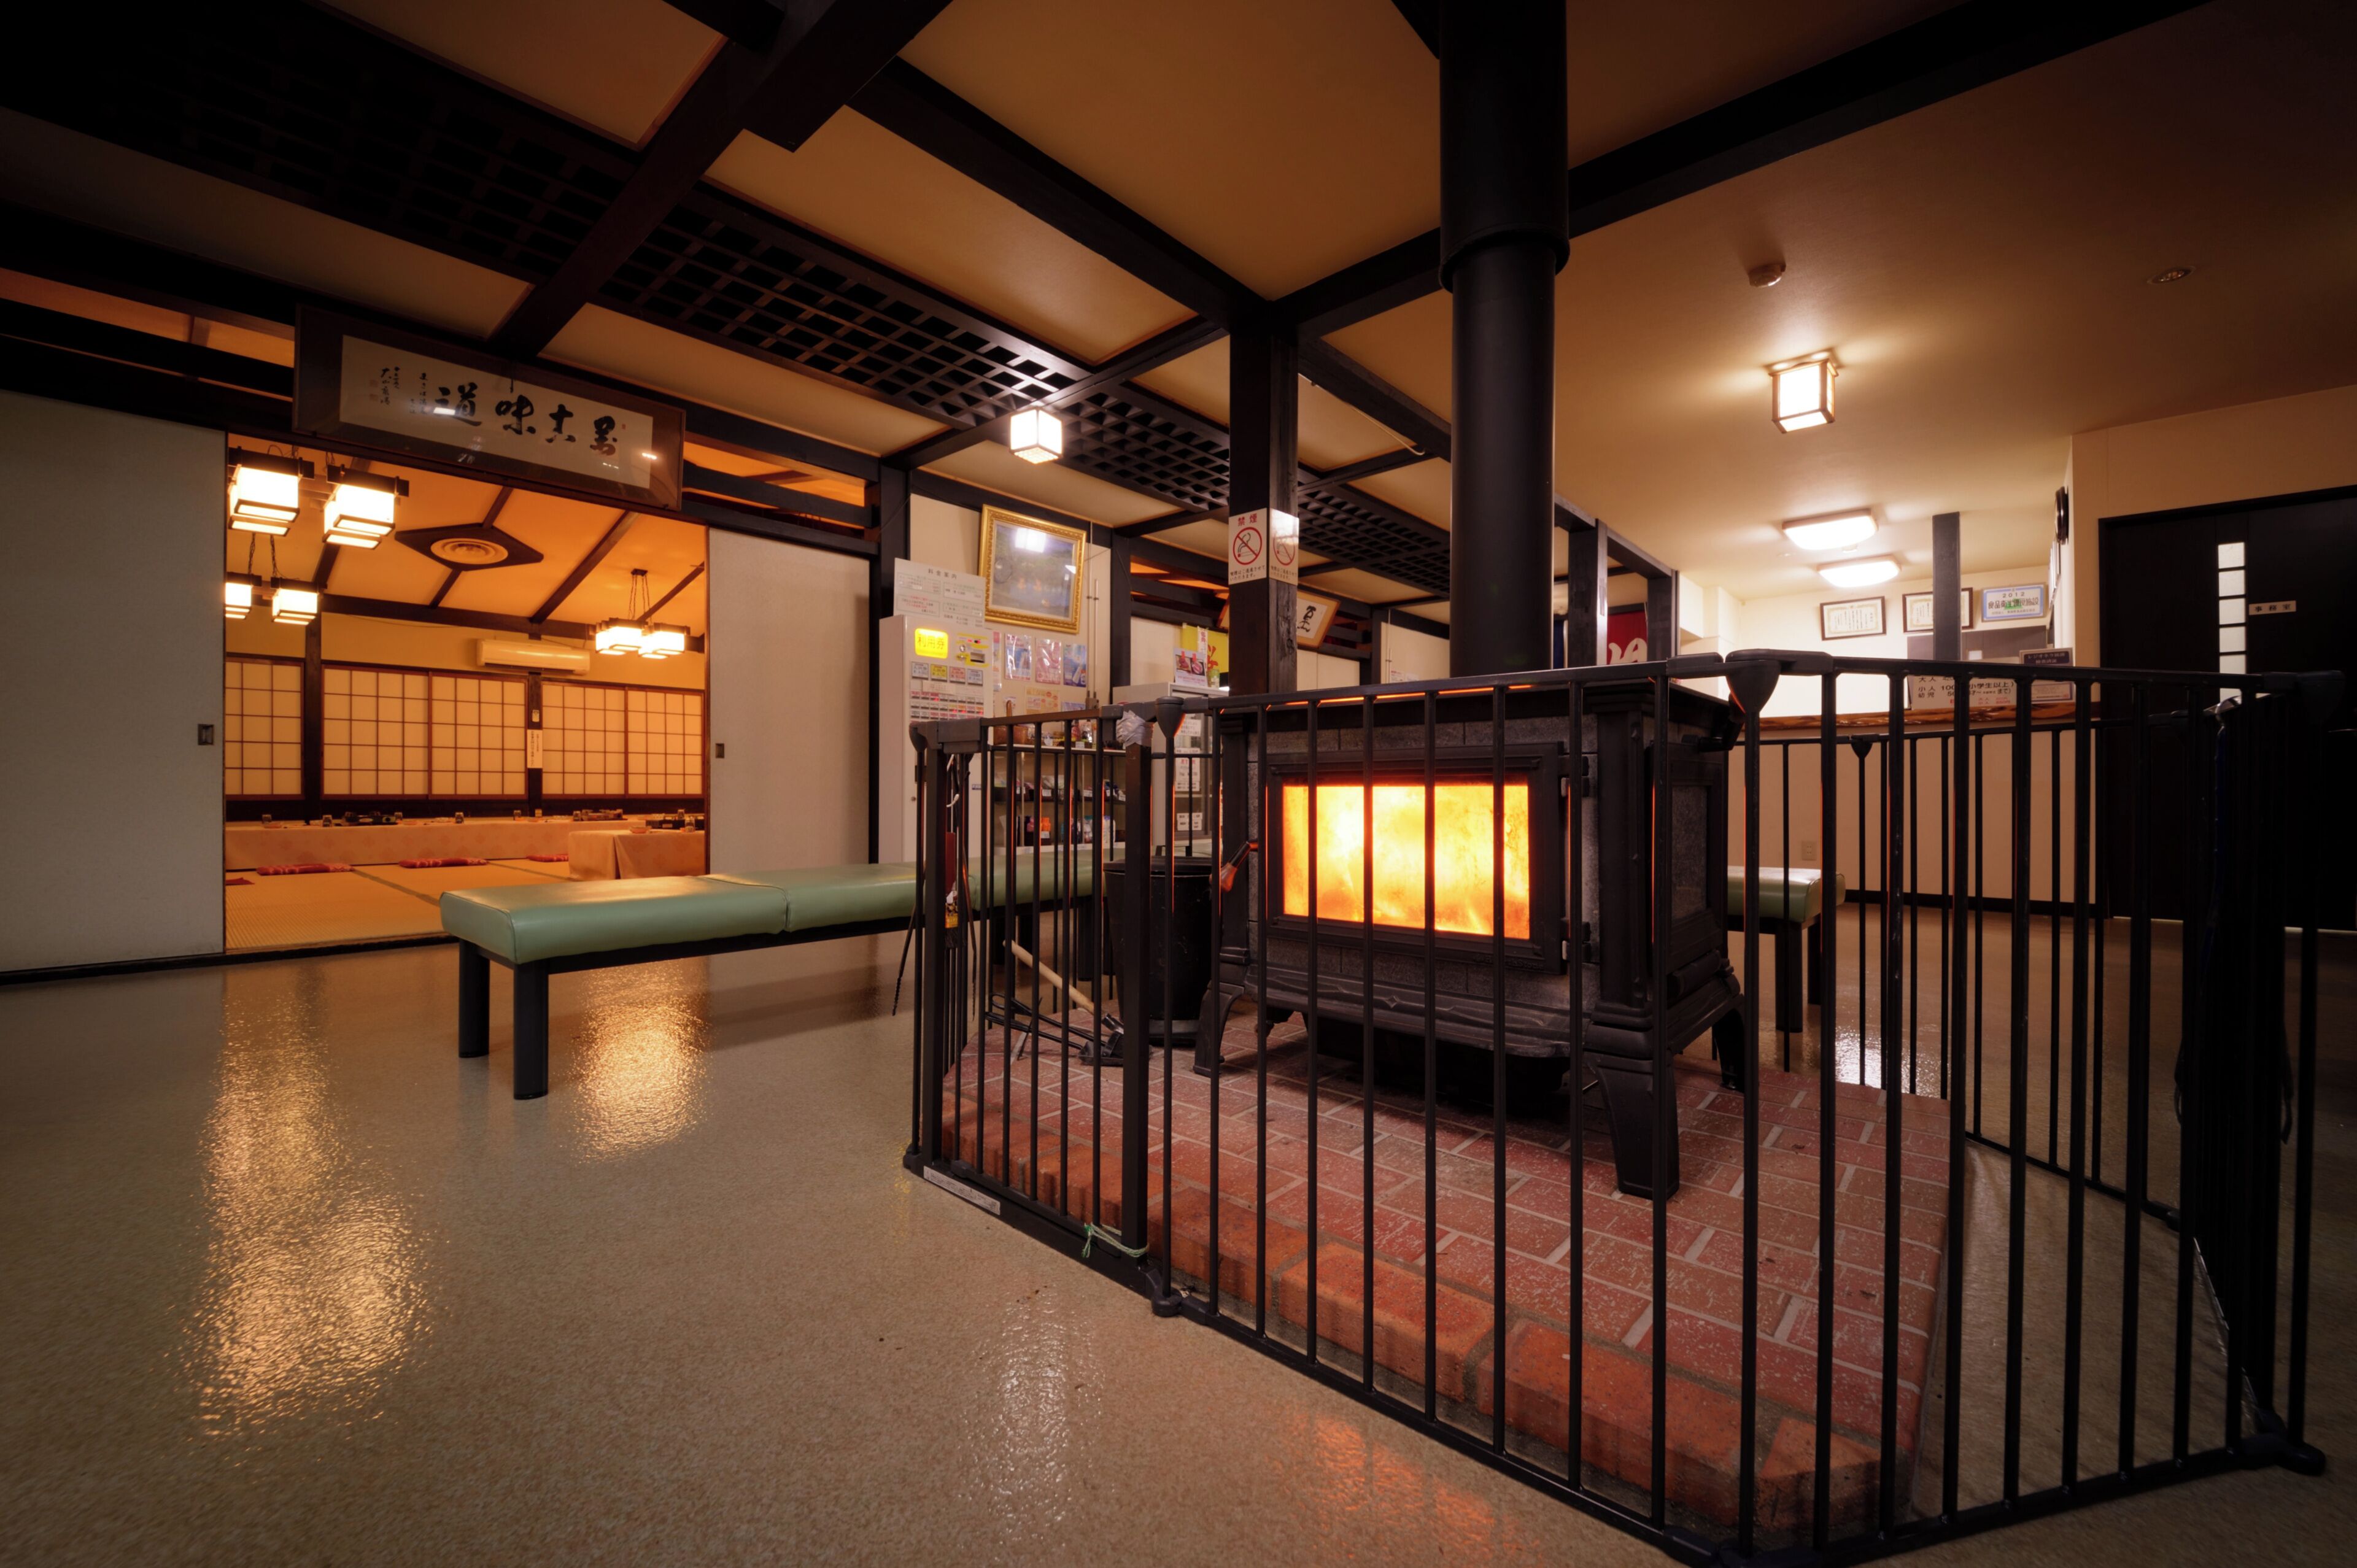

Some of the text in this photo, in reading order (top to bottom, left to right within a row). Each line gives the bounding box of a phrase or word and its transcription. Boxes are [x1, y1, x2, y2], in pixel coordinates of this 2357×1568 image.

[1237, 513, 1258, 527] 禁煙
[927, 568, 958, 579] 料金案内
[1988, 597, 2039, 609] 食品衛生優良施設
[917, 634, 945, 650] 利用券
